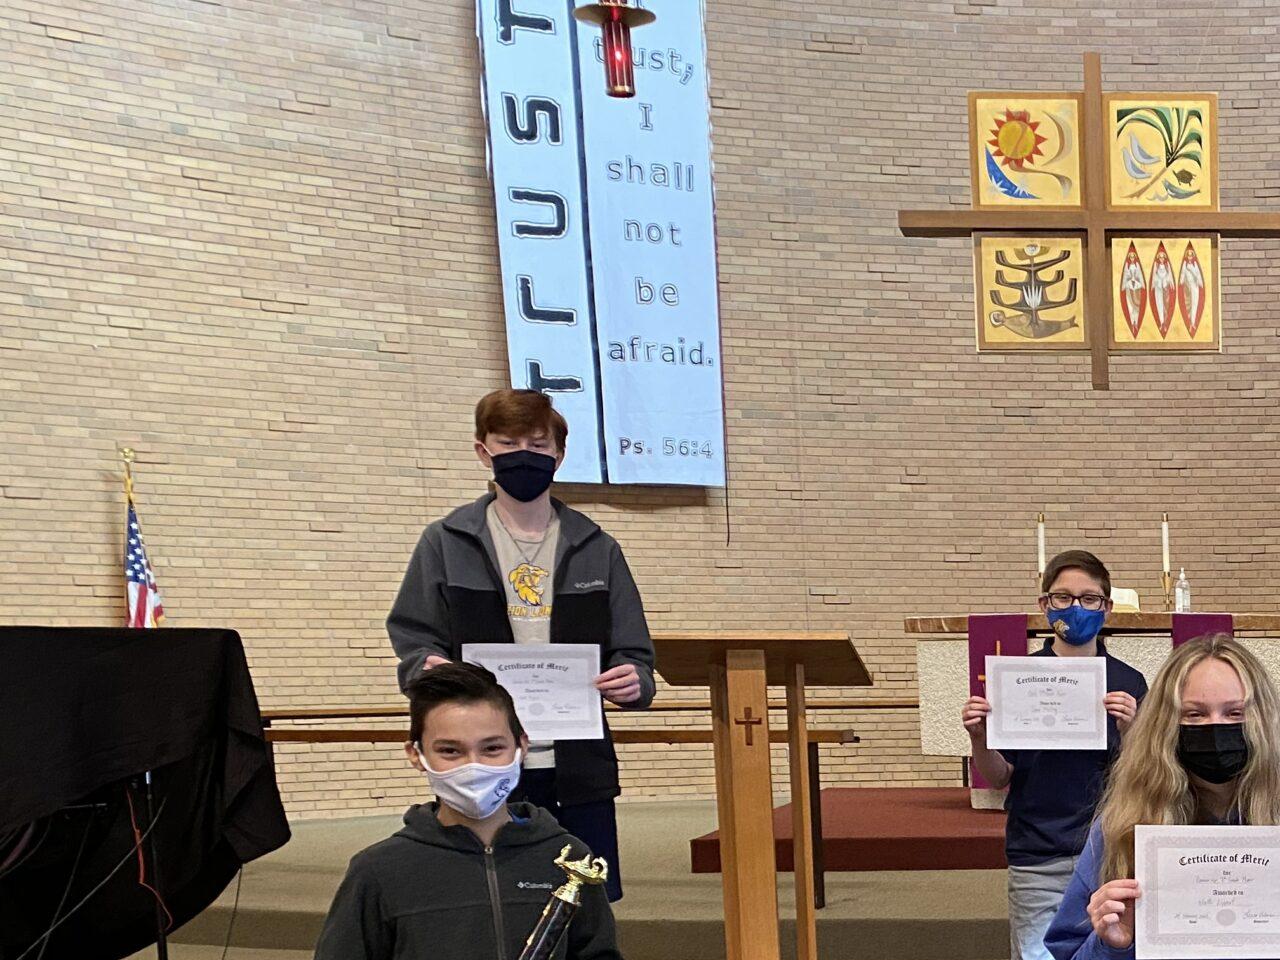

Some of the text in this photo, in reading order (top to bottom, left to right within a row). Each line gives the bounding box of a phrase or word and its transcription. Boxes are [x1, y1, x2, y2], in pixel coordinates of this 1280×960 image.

[593, 36, 693, 85] tust;
[639, 103, 653, 131] I
[606, 155, 694, 192] shall
[624, 219, 681, 246] not
[635, 276, 679, 306] be
[607, 336, 713, 367] afraid.
[619, 437, 714, 459] Ps. 56:4
[1179, 853, 1270, 866] Certificate of Merit
